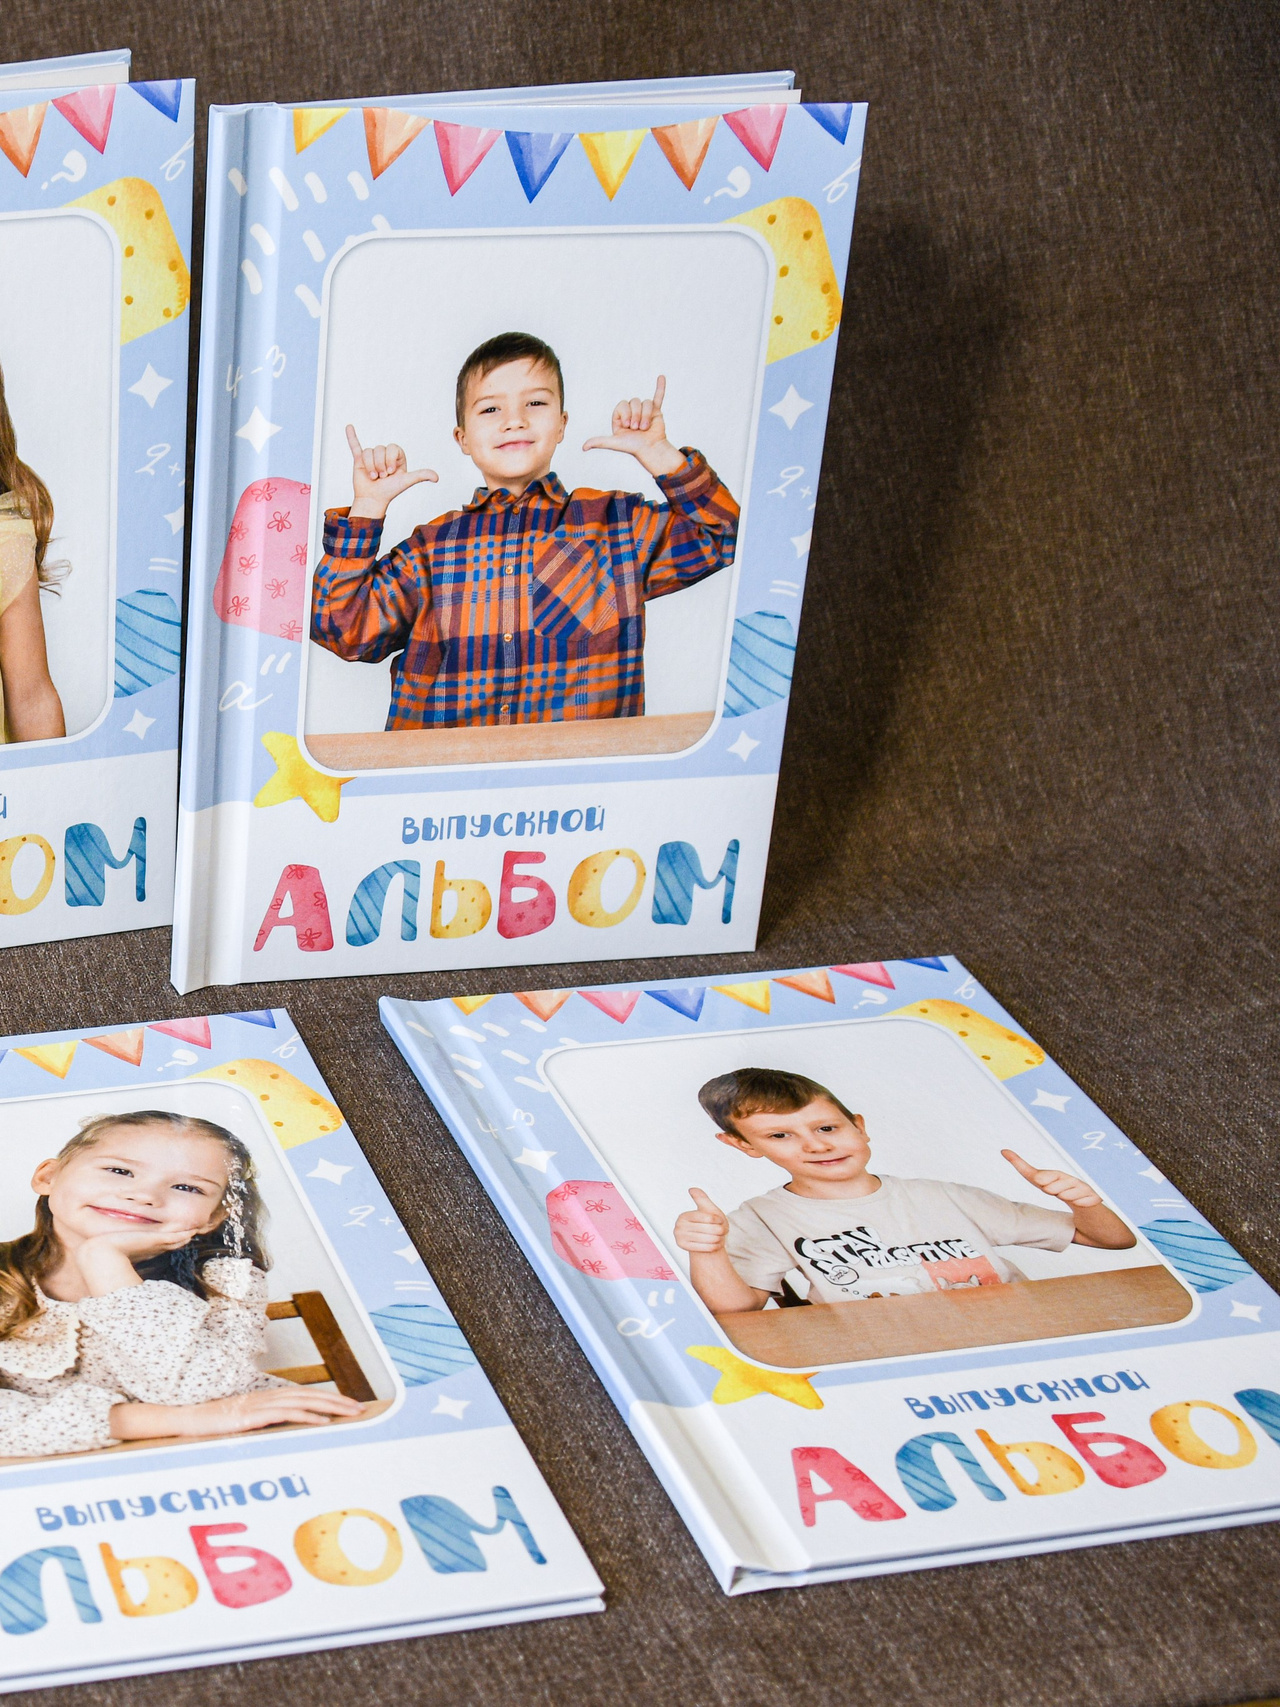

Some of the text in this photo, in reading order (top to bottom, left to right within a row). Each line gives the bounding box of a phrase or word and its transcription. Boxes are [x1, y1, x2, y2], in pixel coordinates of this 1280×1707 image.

[402, 806, 605, 844] ВЫПУСКНОЙ
[253, 839, 740, 952] АЛЬБОМ
[794, 1226, 887, 1275] STAY
[861, 1239, 982, 1269] POSITIVE
[905, 1369, 1150, 1420] ВЫПУСКНОЙ
[36, 1473, 310, 1531] ВЫПУСКНОЙ
